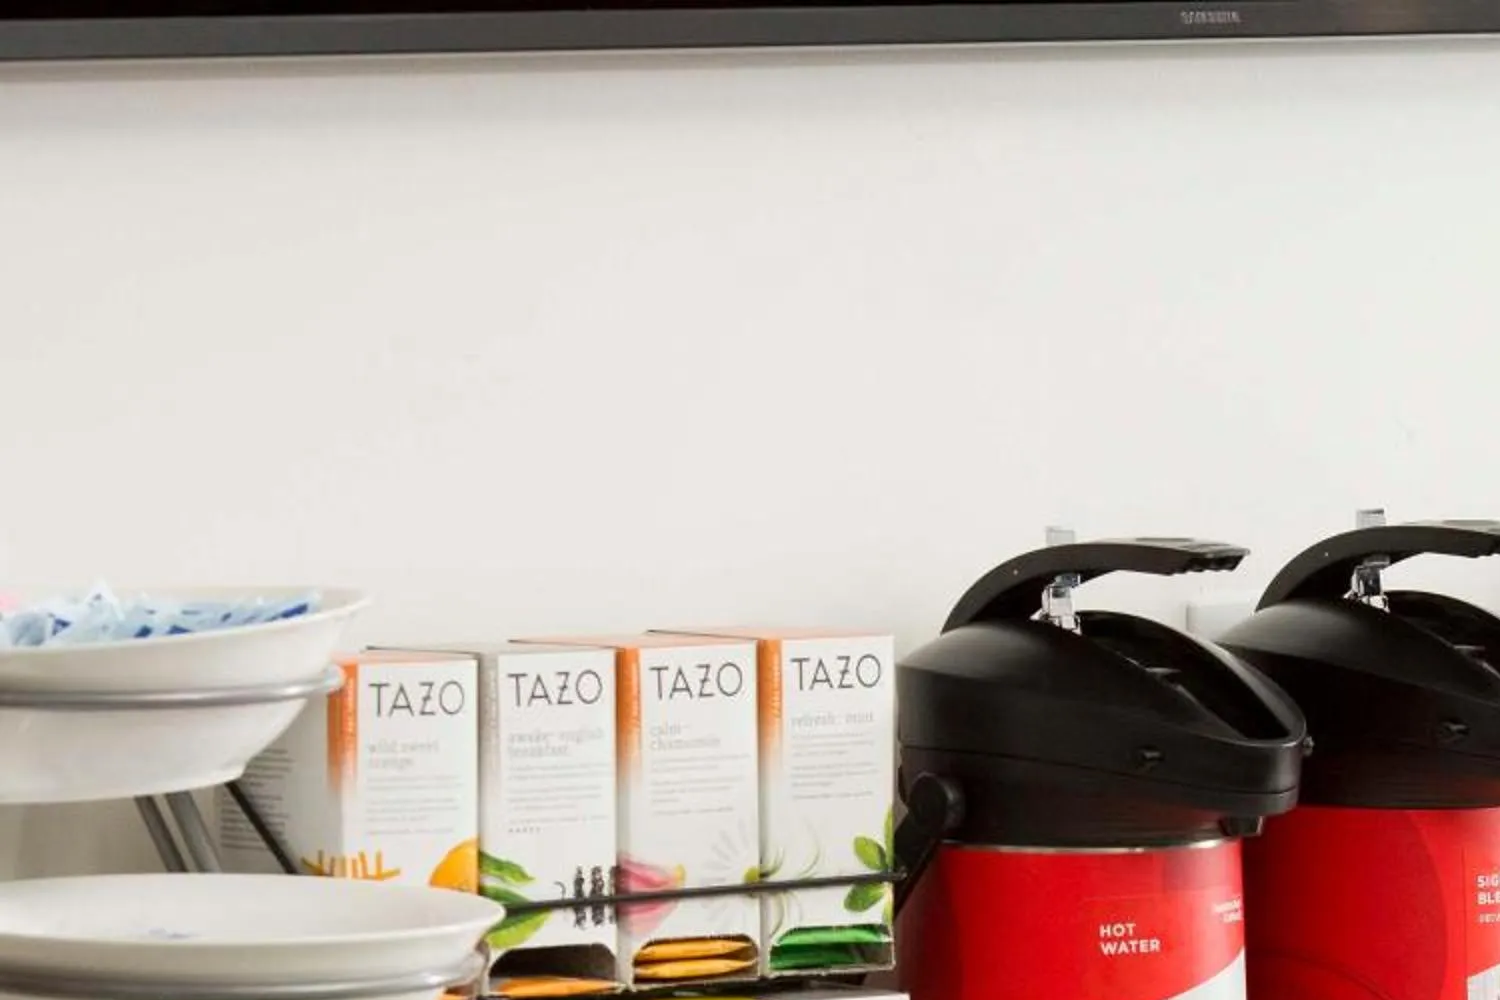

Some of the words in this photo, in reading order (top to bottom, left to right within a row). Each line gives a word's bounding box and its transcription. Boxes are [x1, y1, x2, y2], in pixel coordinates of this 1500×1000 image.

[507, 669, 604, 707] TAZO
[648, 662, 744, 700] TAZO
[789, 653, 882, 691] TAZO
[368, 680, 466, 718] TAZO
[1099, 921, 1136, 938] HOT
[1099, 938, 1161, 955] WATER
